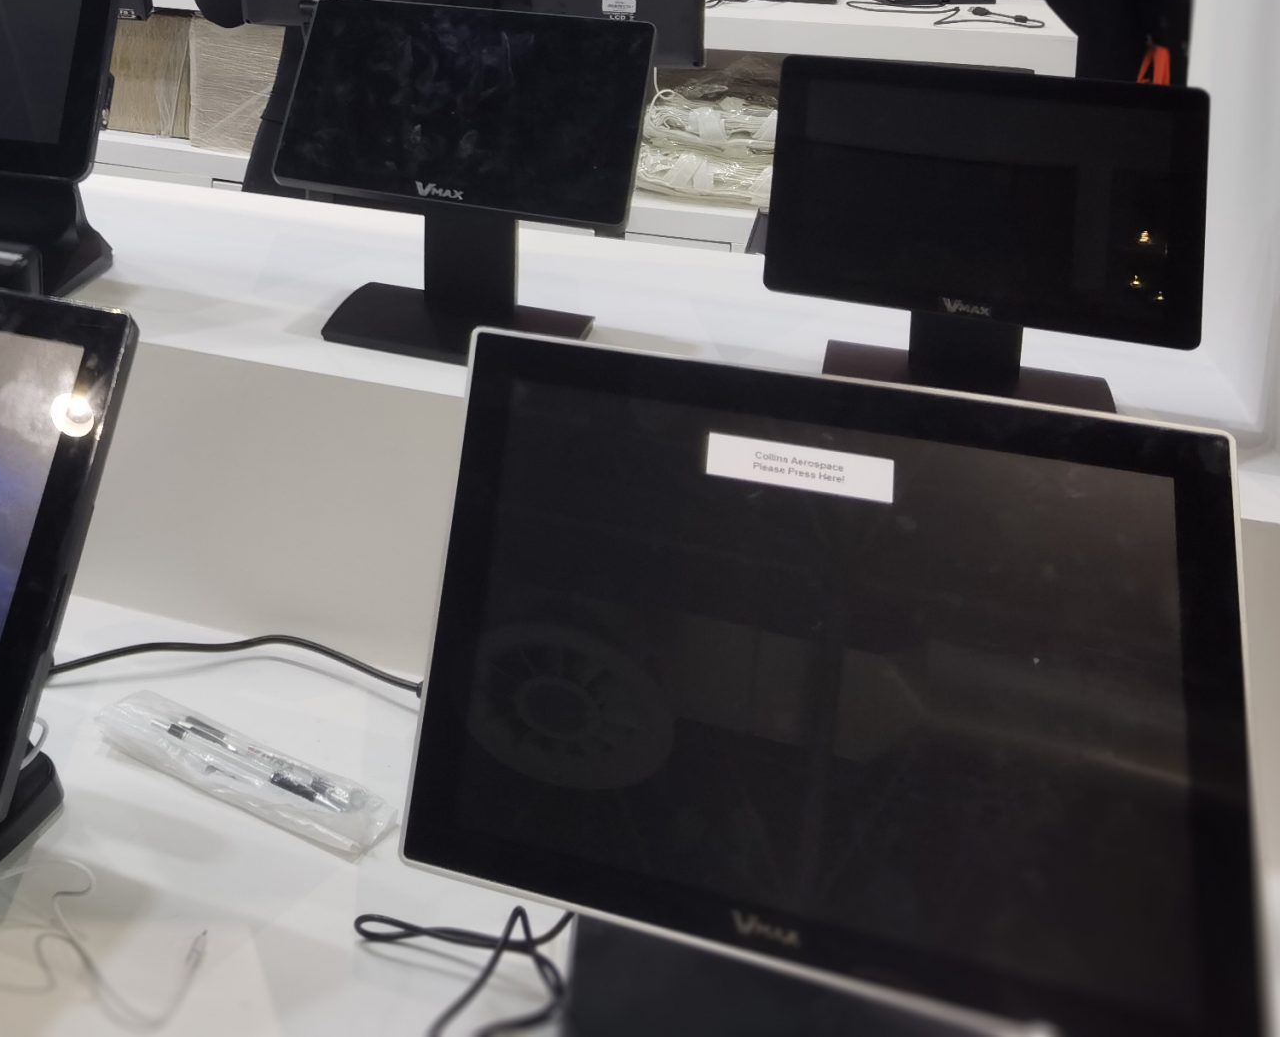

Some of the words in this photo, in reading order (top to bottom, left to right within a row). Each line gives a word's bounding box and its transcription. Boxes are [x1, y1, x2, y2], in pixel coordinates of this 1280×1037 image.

[753, 461, 785, 475] Please
[787, 467, 816, 480] Press
[818, 472, 845, 484] Here!
[754, 450, 789, 464] Collins
[791, 456, 844, 473] Aerospace
